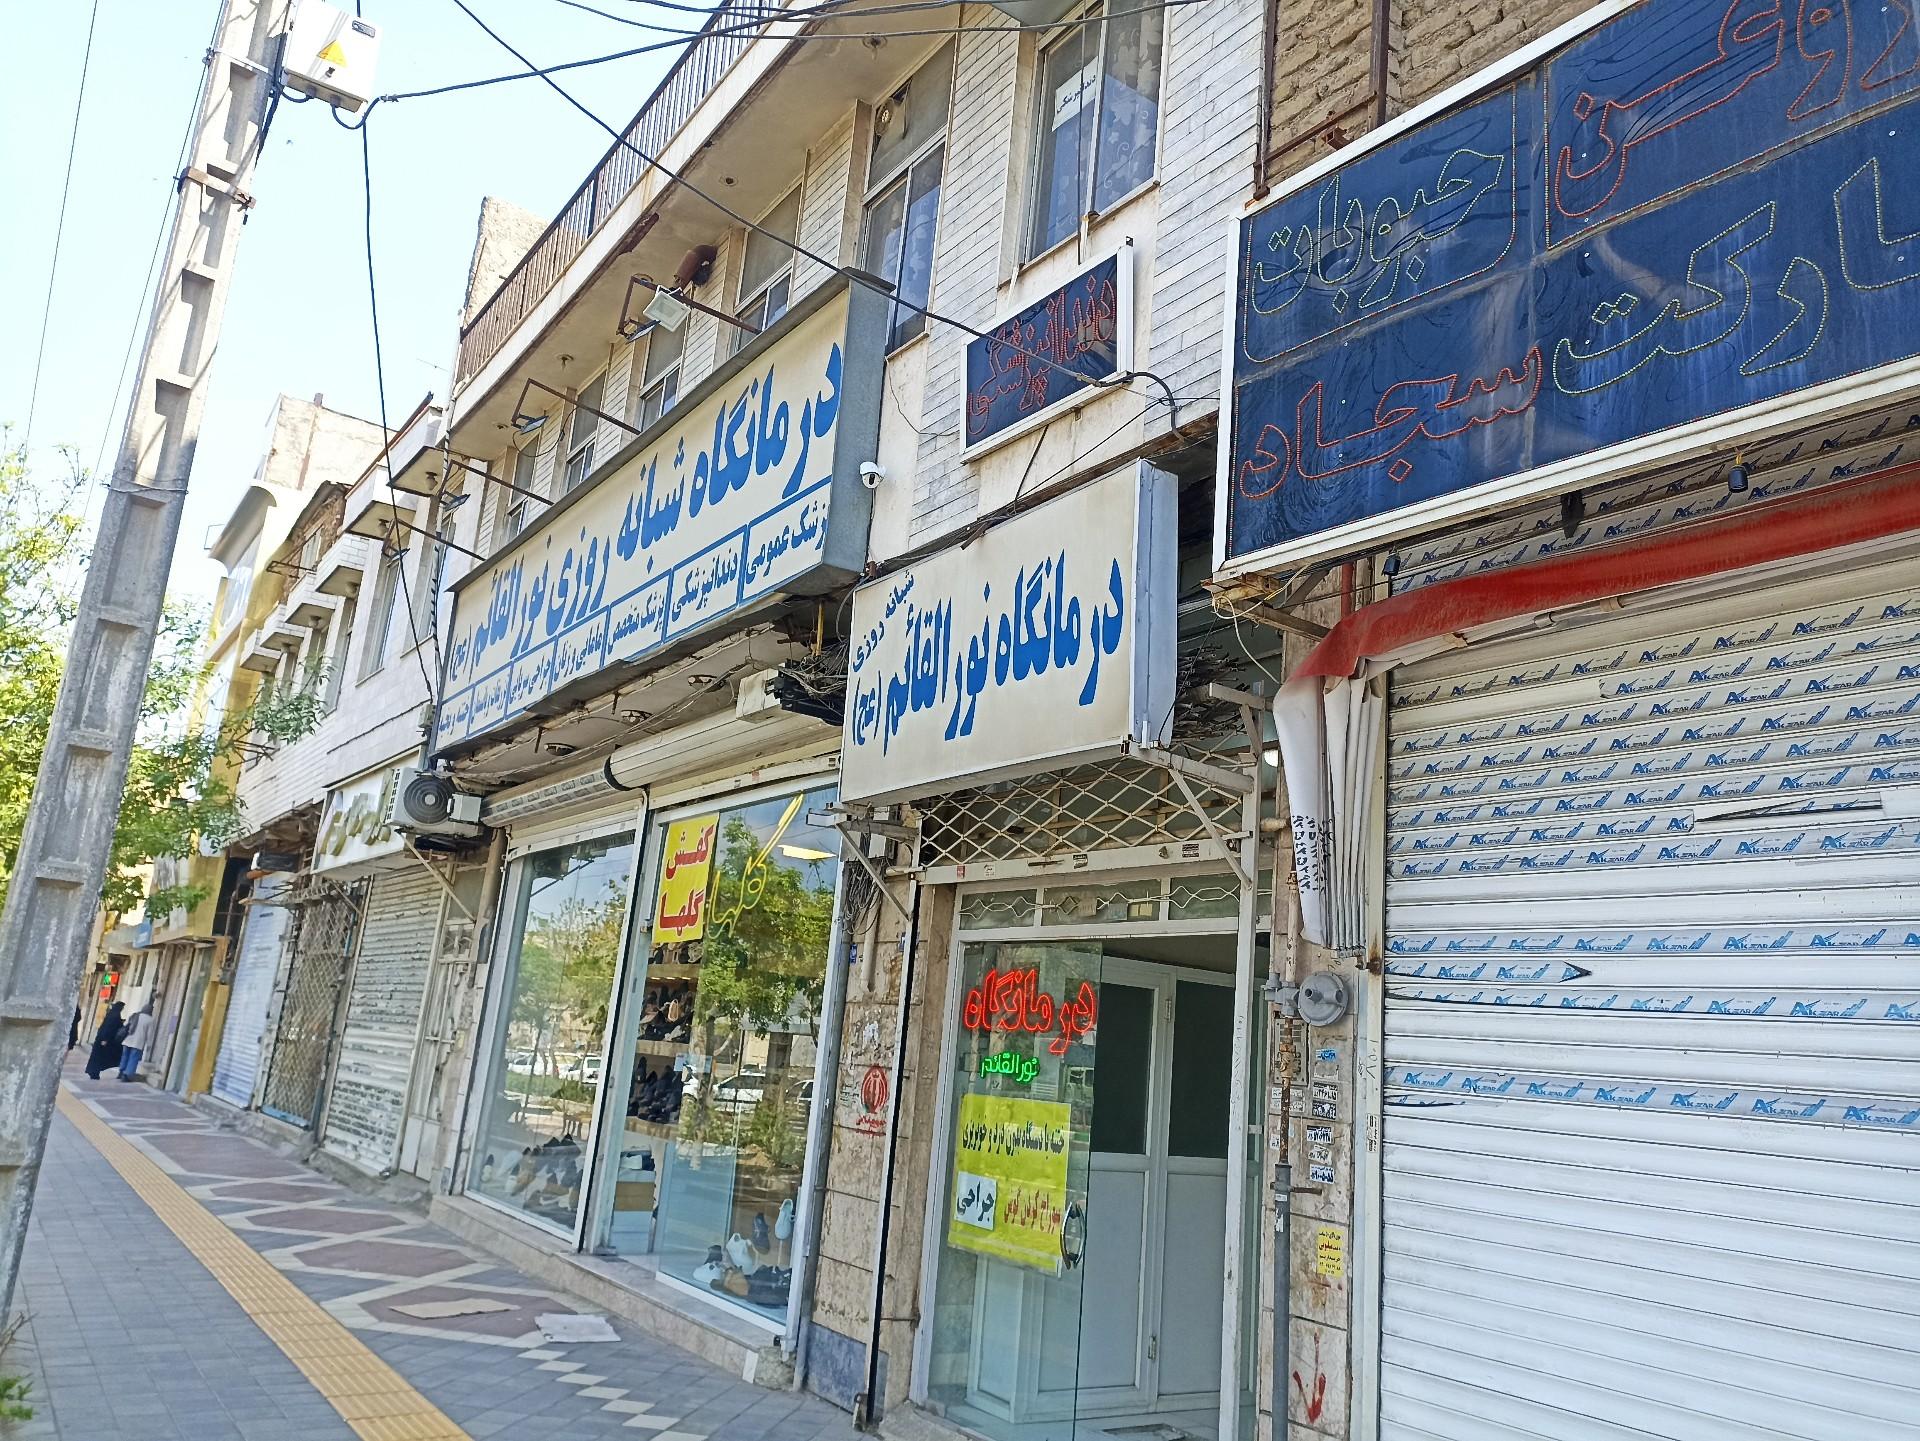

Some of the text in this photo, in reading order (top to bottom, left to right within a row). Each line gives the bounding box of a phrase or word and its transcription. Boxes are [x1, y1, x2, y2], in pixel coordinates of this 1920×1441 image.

[1252, 148, 1504, 314] حبوبات
[689, 343, 843, 518] درمانگاه
[1240, 346, 1541, 499] سجاد
[616, 437, 684, 572] شبانه
[546, 526, 610, 636] روزی
[672, 547, 737, 622] دندانپزشکی
[746, 525, 789, 584] عمومی
[885, 569, 914, 619] شبانه
[995, 548, 1124, 706] درمانگاه
[665, 825, 714, 880] کفش
[659, 889, 705, 936] گلها
[963, 968, 1096, 1053] درمانگاه
[957, 1181, 994, 1221] جراحی
